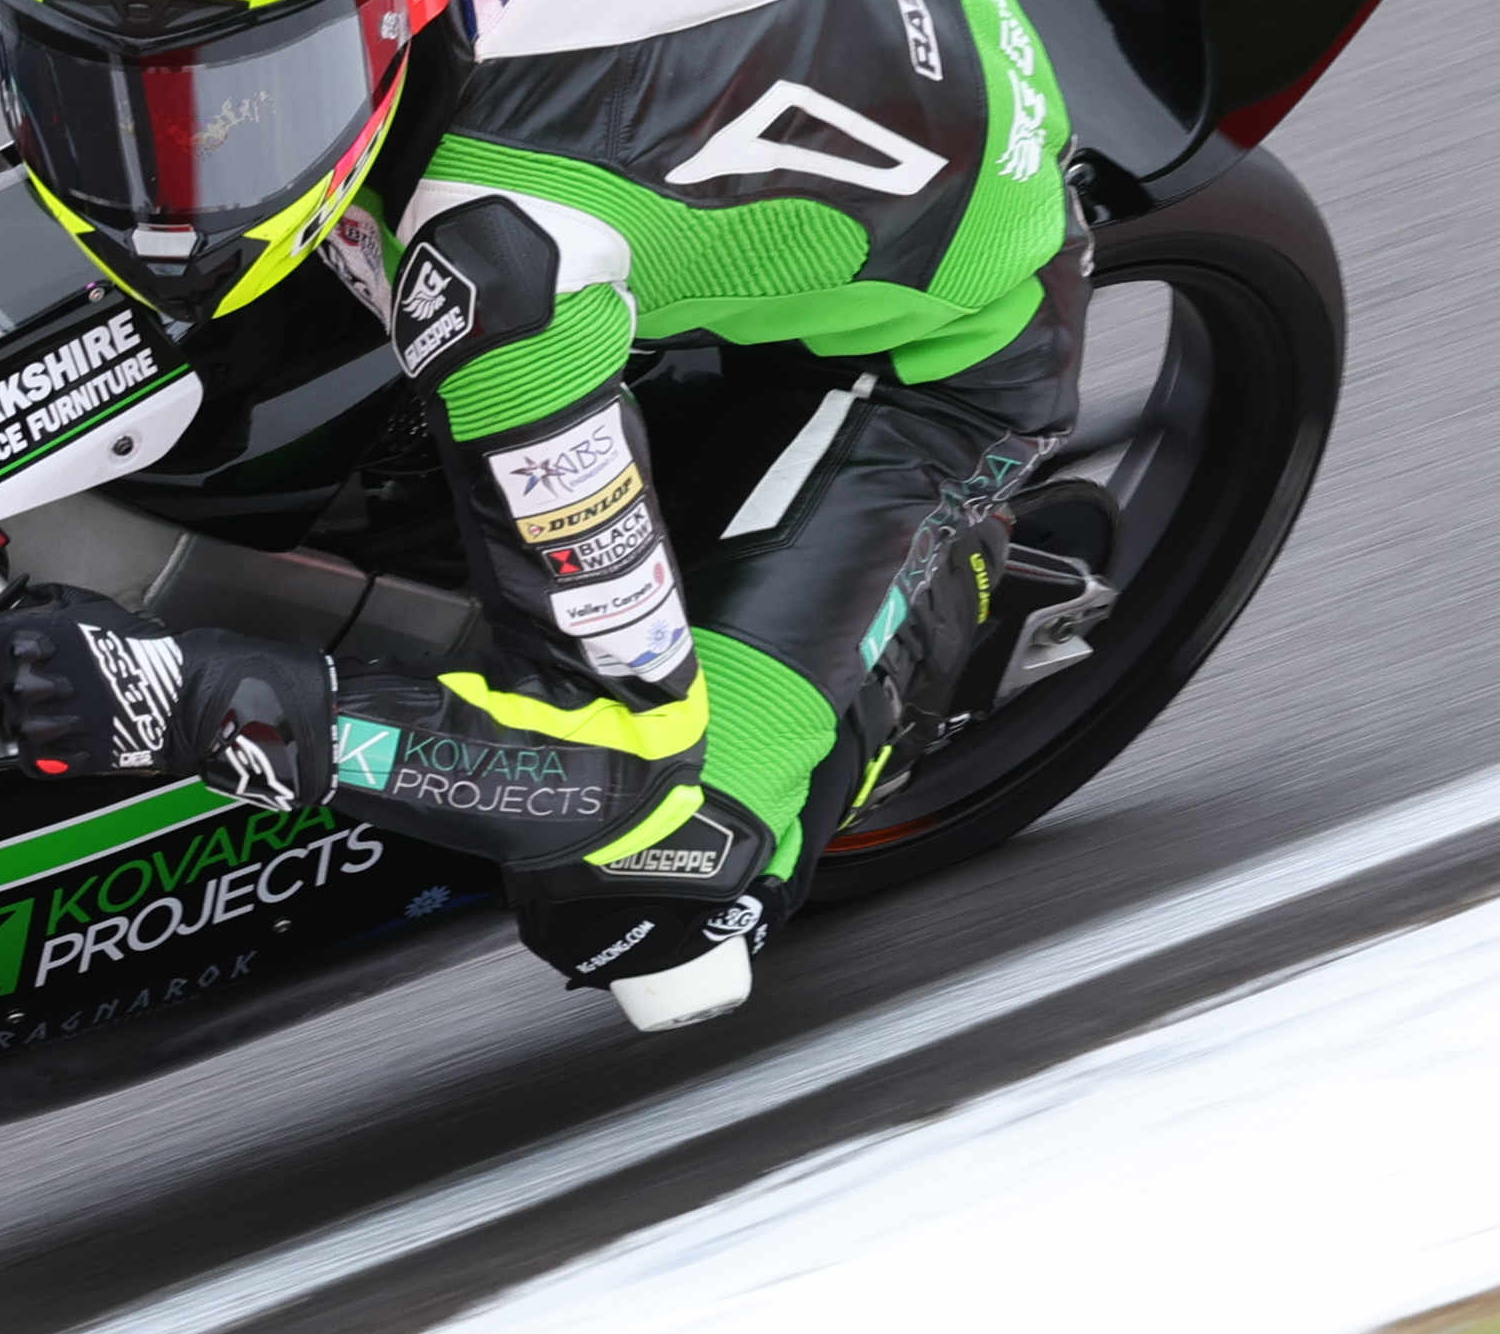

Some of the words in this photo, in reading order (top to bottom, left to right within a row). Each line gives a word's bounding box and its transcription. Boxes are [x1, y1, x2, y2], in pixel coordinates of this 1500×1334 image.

[27, 347, 158, 448] FURNITURE
[549, 477, 635, 532] DUNLOP
[578, 509, 645, 557] BLACK
[581, 523, 650, 569] WIDOW
[566, 602, 609, 619] Valley
[403, 731, 568, 783] KOVARA
[392, 768, 603, 816] PROJECTS
[46, 804, 337, 936] KOVARA
[34, 822, 384, 988] PROJECTS
